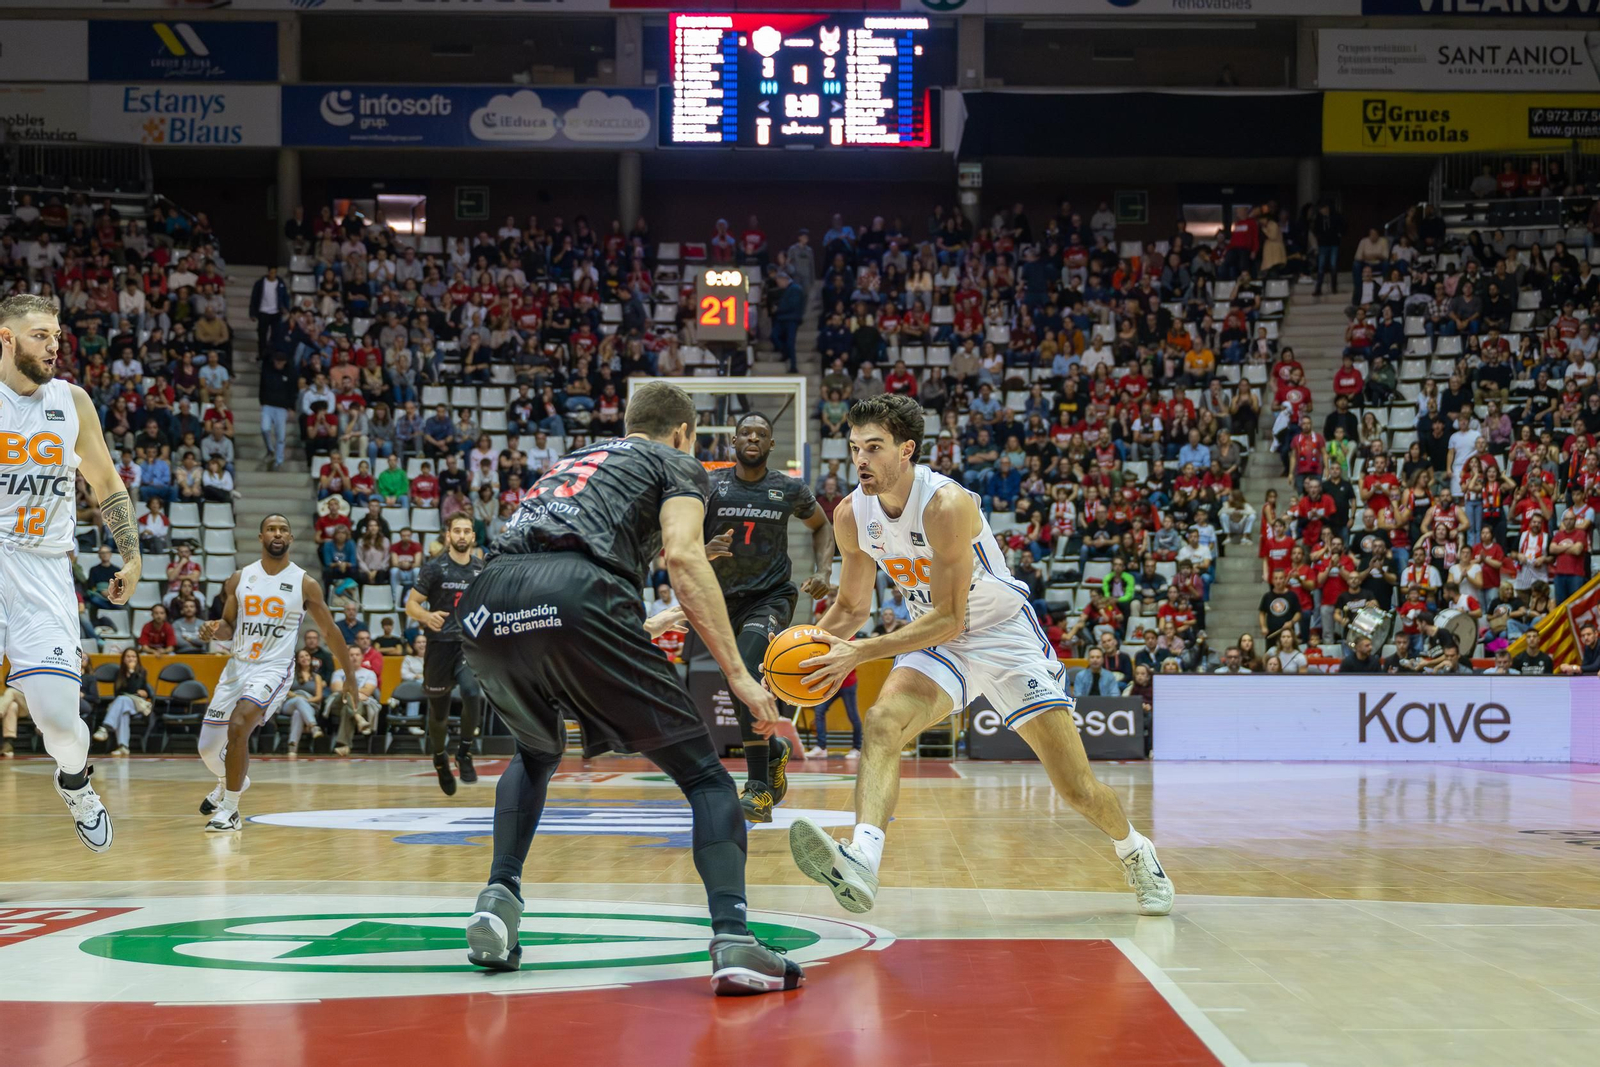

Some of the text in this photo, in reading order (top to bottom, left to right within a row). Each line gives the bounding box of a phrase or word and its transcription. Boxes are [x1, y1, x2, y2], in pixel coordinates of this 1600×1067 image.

[1438, 45, 1583, 65] SANT ANIOL
[123, 87, 225, 119] Estanys
[359, 93, 451, 116] infosoft
[359, 118, 389, 130] grup.
[500, 116, 547, 128] iEduca
[1388, 106, 1450, 122] Grues
[1546, 110, 1600, 122] 972.87.5
[169, 119, 242, 144] Blaus
[1388, 126, 1469, 142] Viñolas
[701, 296, 736, 325] 21
[14, 506, 47, 536] 12
[743, 521, 756, 545] 7
[244, 595, 285, 618] BG
[493, 604, 558, 624] Diputación
[241, 622, 286, 638] FIATC
[494, 616, 562, 637] de Granada
[248, 642, 263, 660] 5
[1358, 691, 1511, 743] Kave
